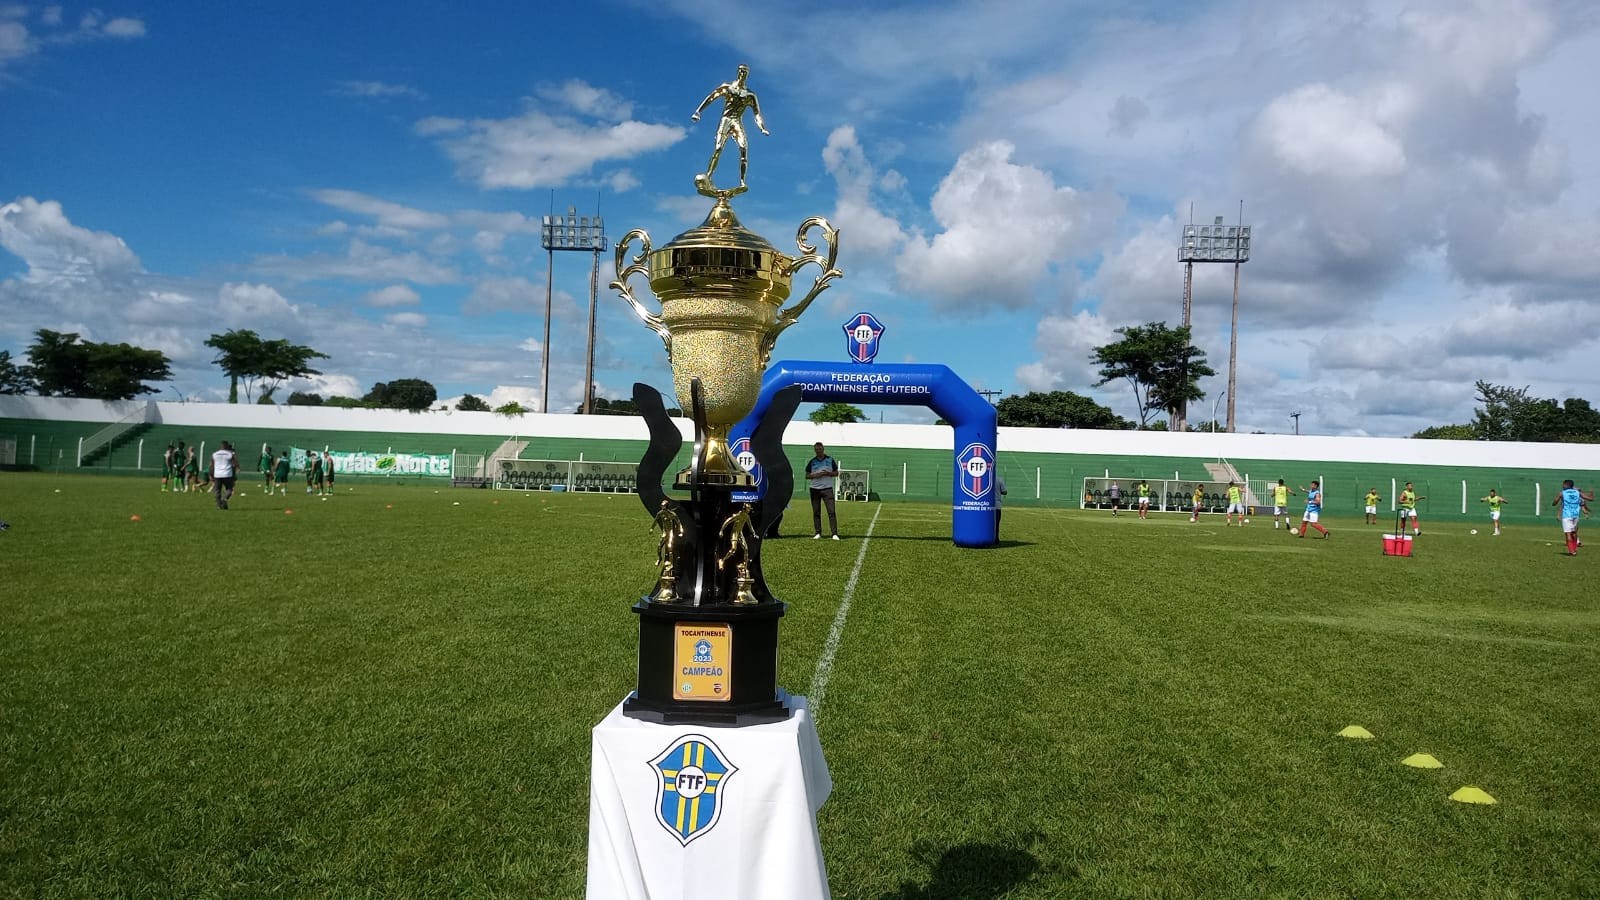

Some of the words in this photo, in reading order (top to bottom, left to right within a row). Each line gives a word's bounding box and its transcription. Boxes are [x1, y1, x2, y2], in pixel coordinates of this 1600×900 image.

[857, 329, 870, 339] FTF
[831, 373, 890, 384] FEDERAÇÃO
[794, 382, 868, 393] OCANTINENSE
[871, 385, 883, 393] DE
[886, 385, 930, 394] FUTEBOL
[396, 454, 449, 474] Norte
[739, 456, 752, 466] FTF
[970, 462, 984, 472] FTF
[682, 666, 723, 676] CAMPEÃO
[678, 774, 704, 790] FTF
